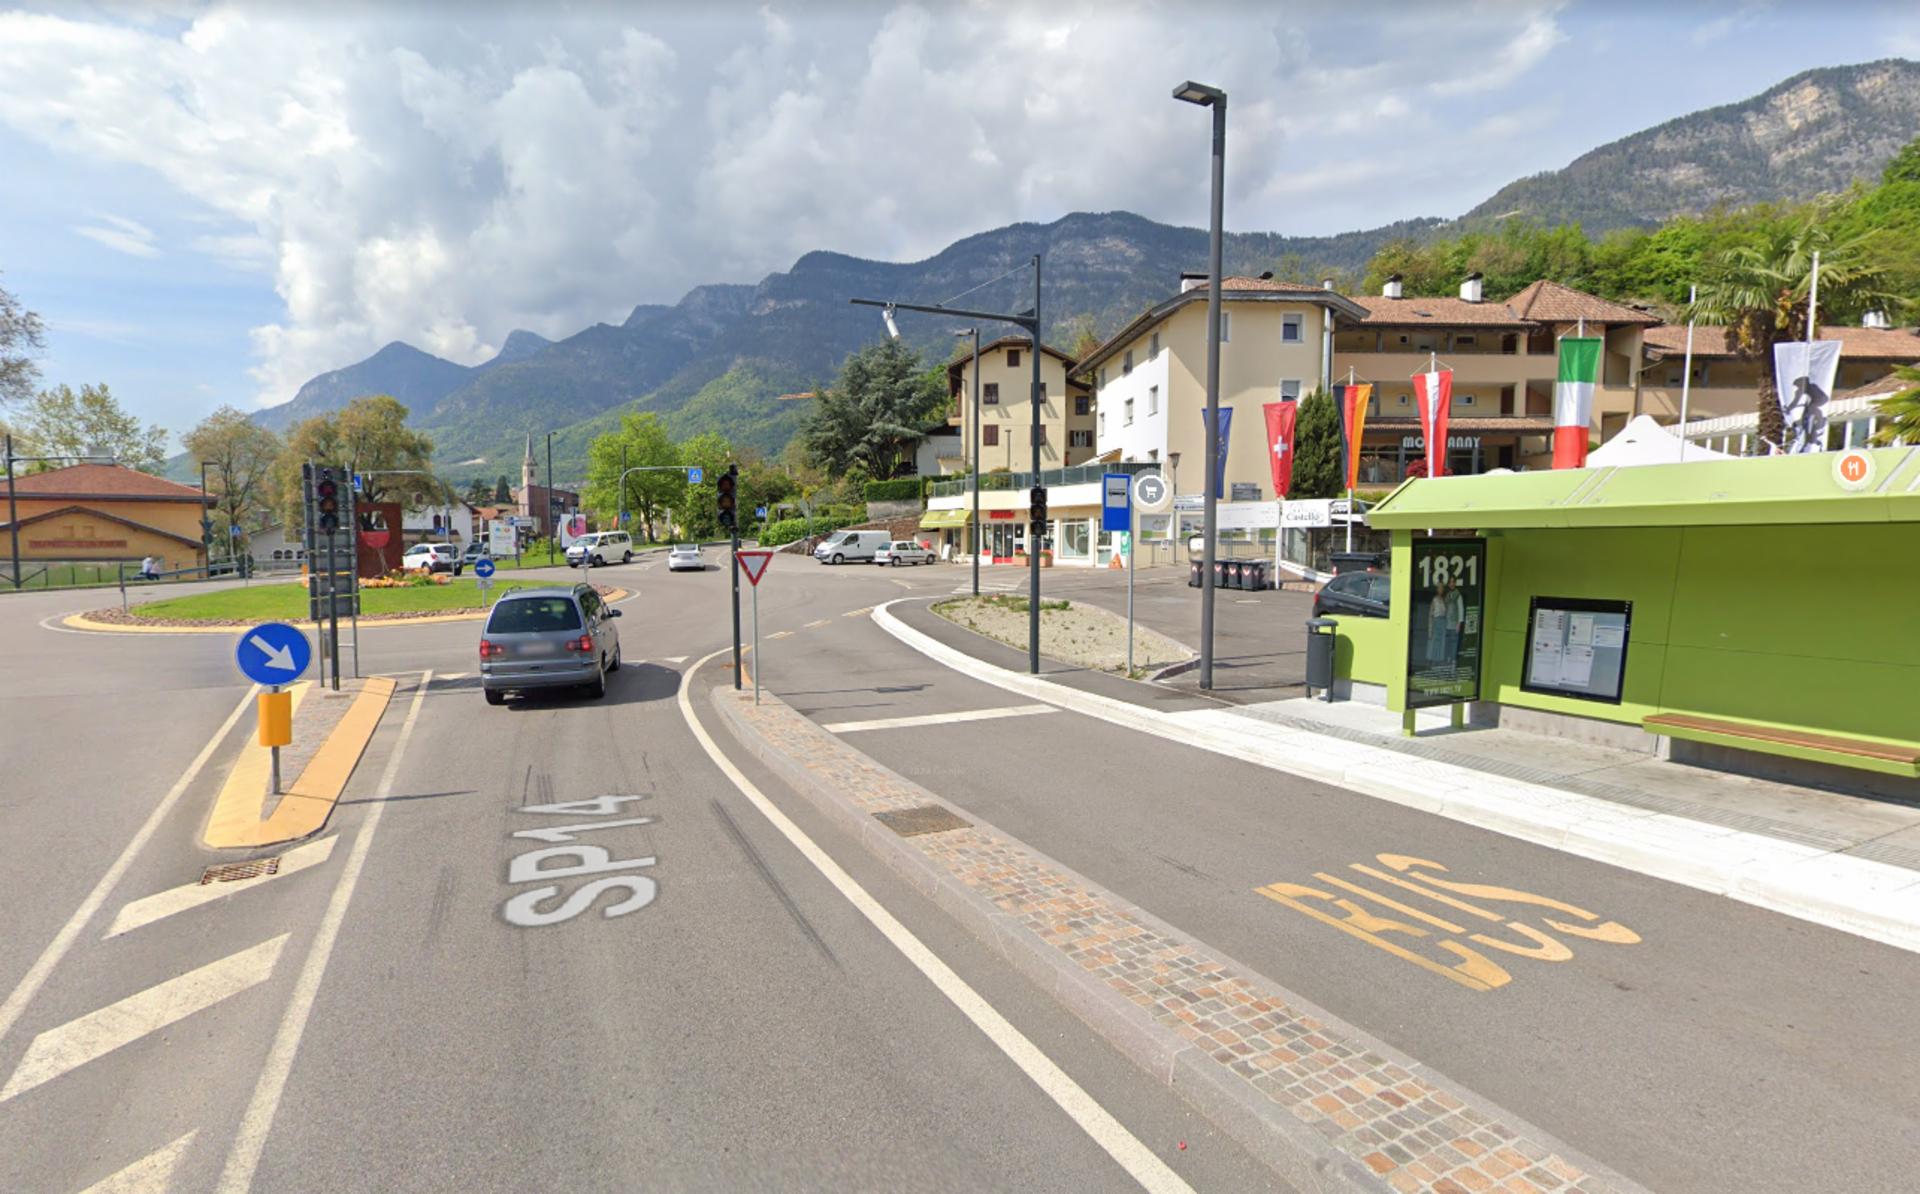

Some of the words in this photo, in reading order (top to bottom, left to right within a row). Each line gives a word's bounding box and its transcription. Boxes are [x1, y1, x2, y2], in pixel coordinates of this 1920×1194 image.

[1418, 554, 1478, 588] 1821
[504, 794, 661, 927] SP14
[1251, 852, 1643, 992] BUS
